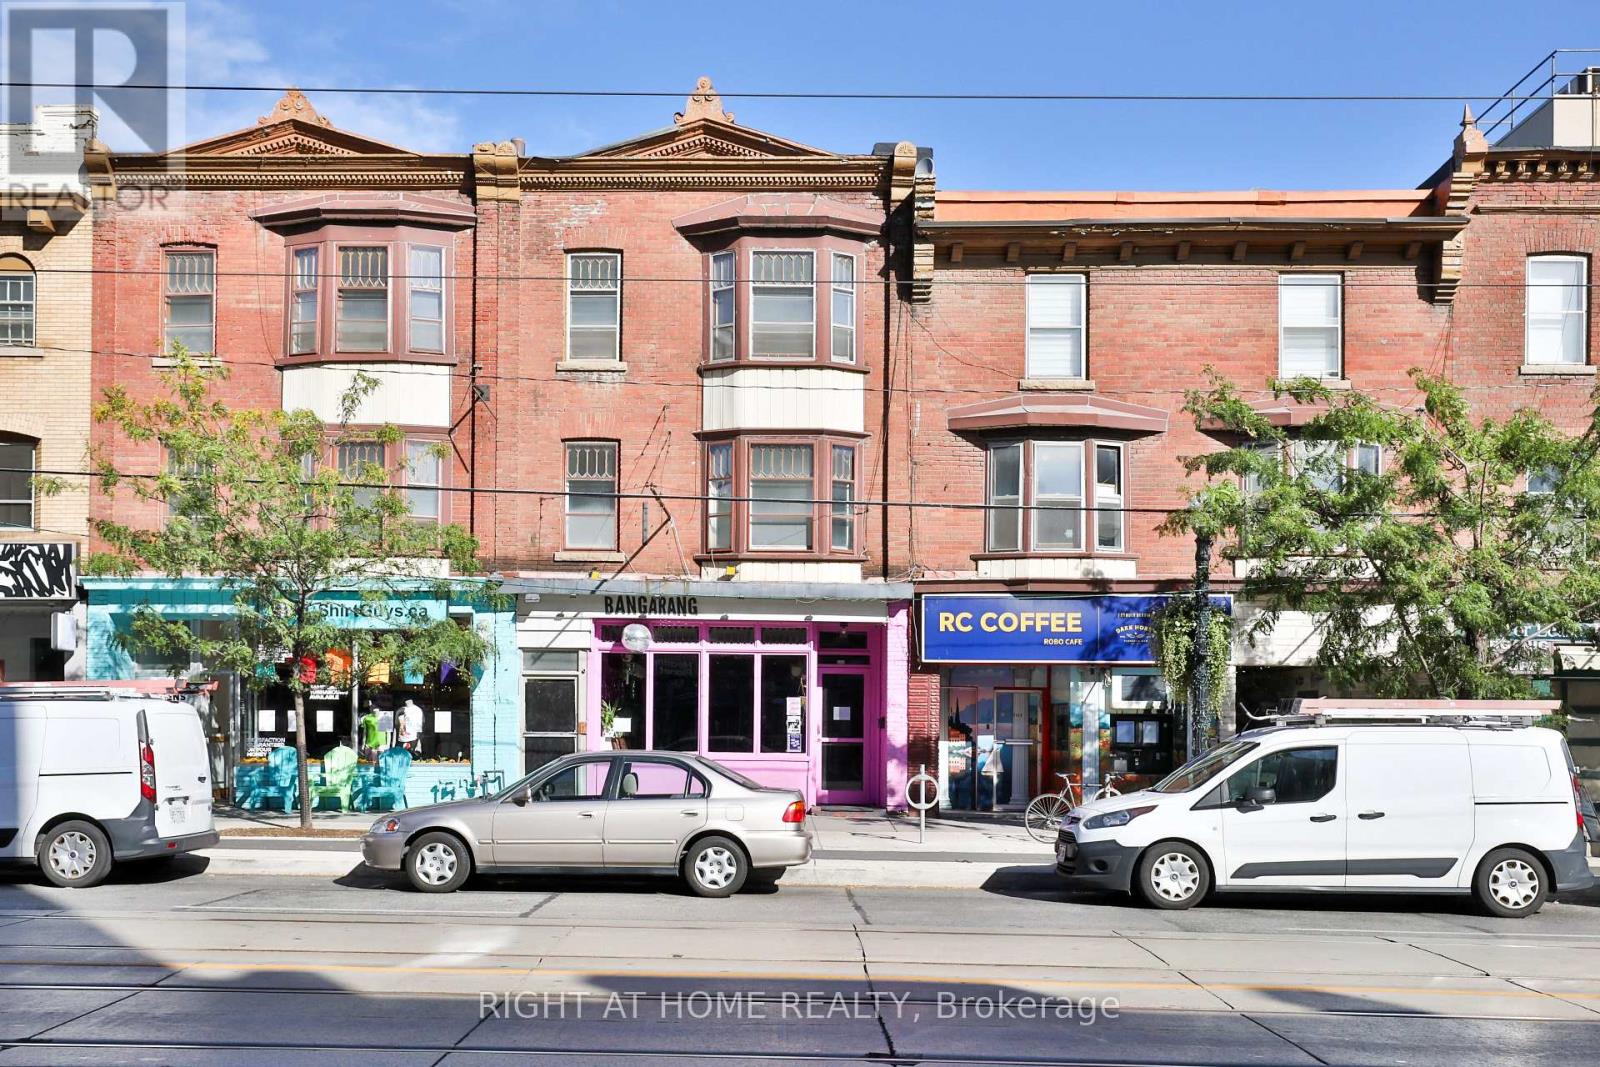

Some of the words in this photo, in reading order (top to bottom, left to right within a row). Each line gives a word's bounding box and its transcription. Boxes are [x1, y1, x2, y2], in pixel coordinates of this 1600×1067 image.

[604, 595, 698, 616] BANGARANG
[939, 612, 973, 632] RC
[980, 612, 1082, 632] COFFEE
[1043, 638, 1064, 646] ROBO
[1065, 638, 1083, 646] CAFE
